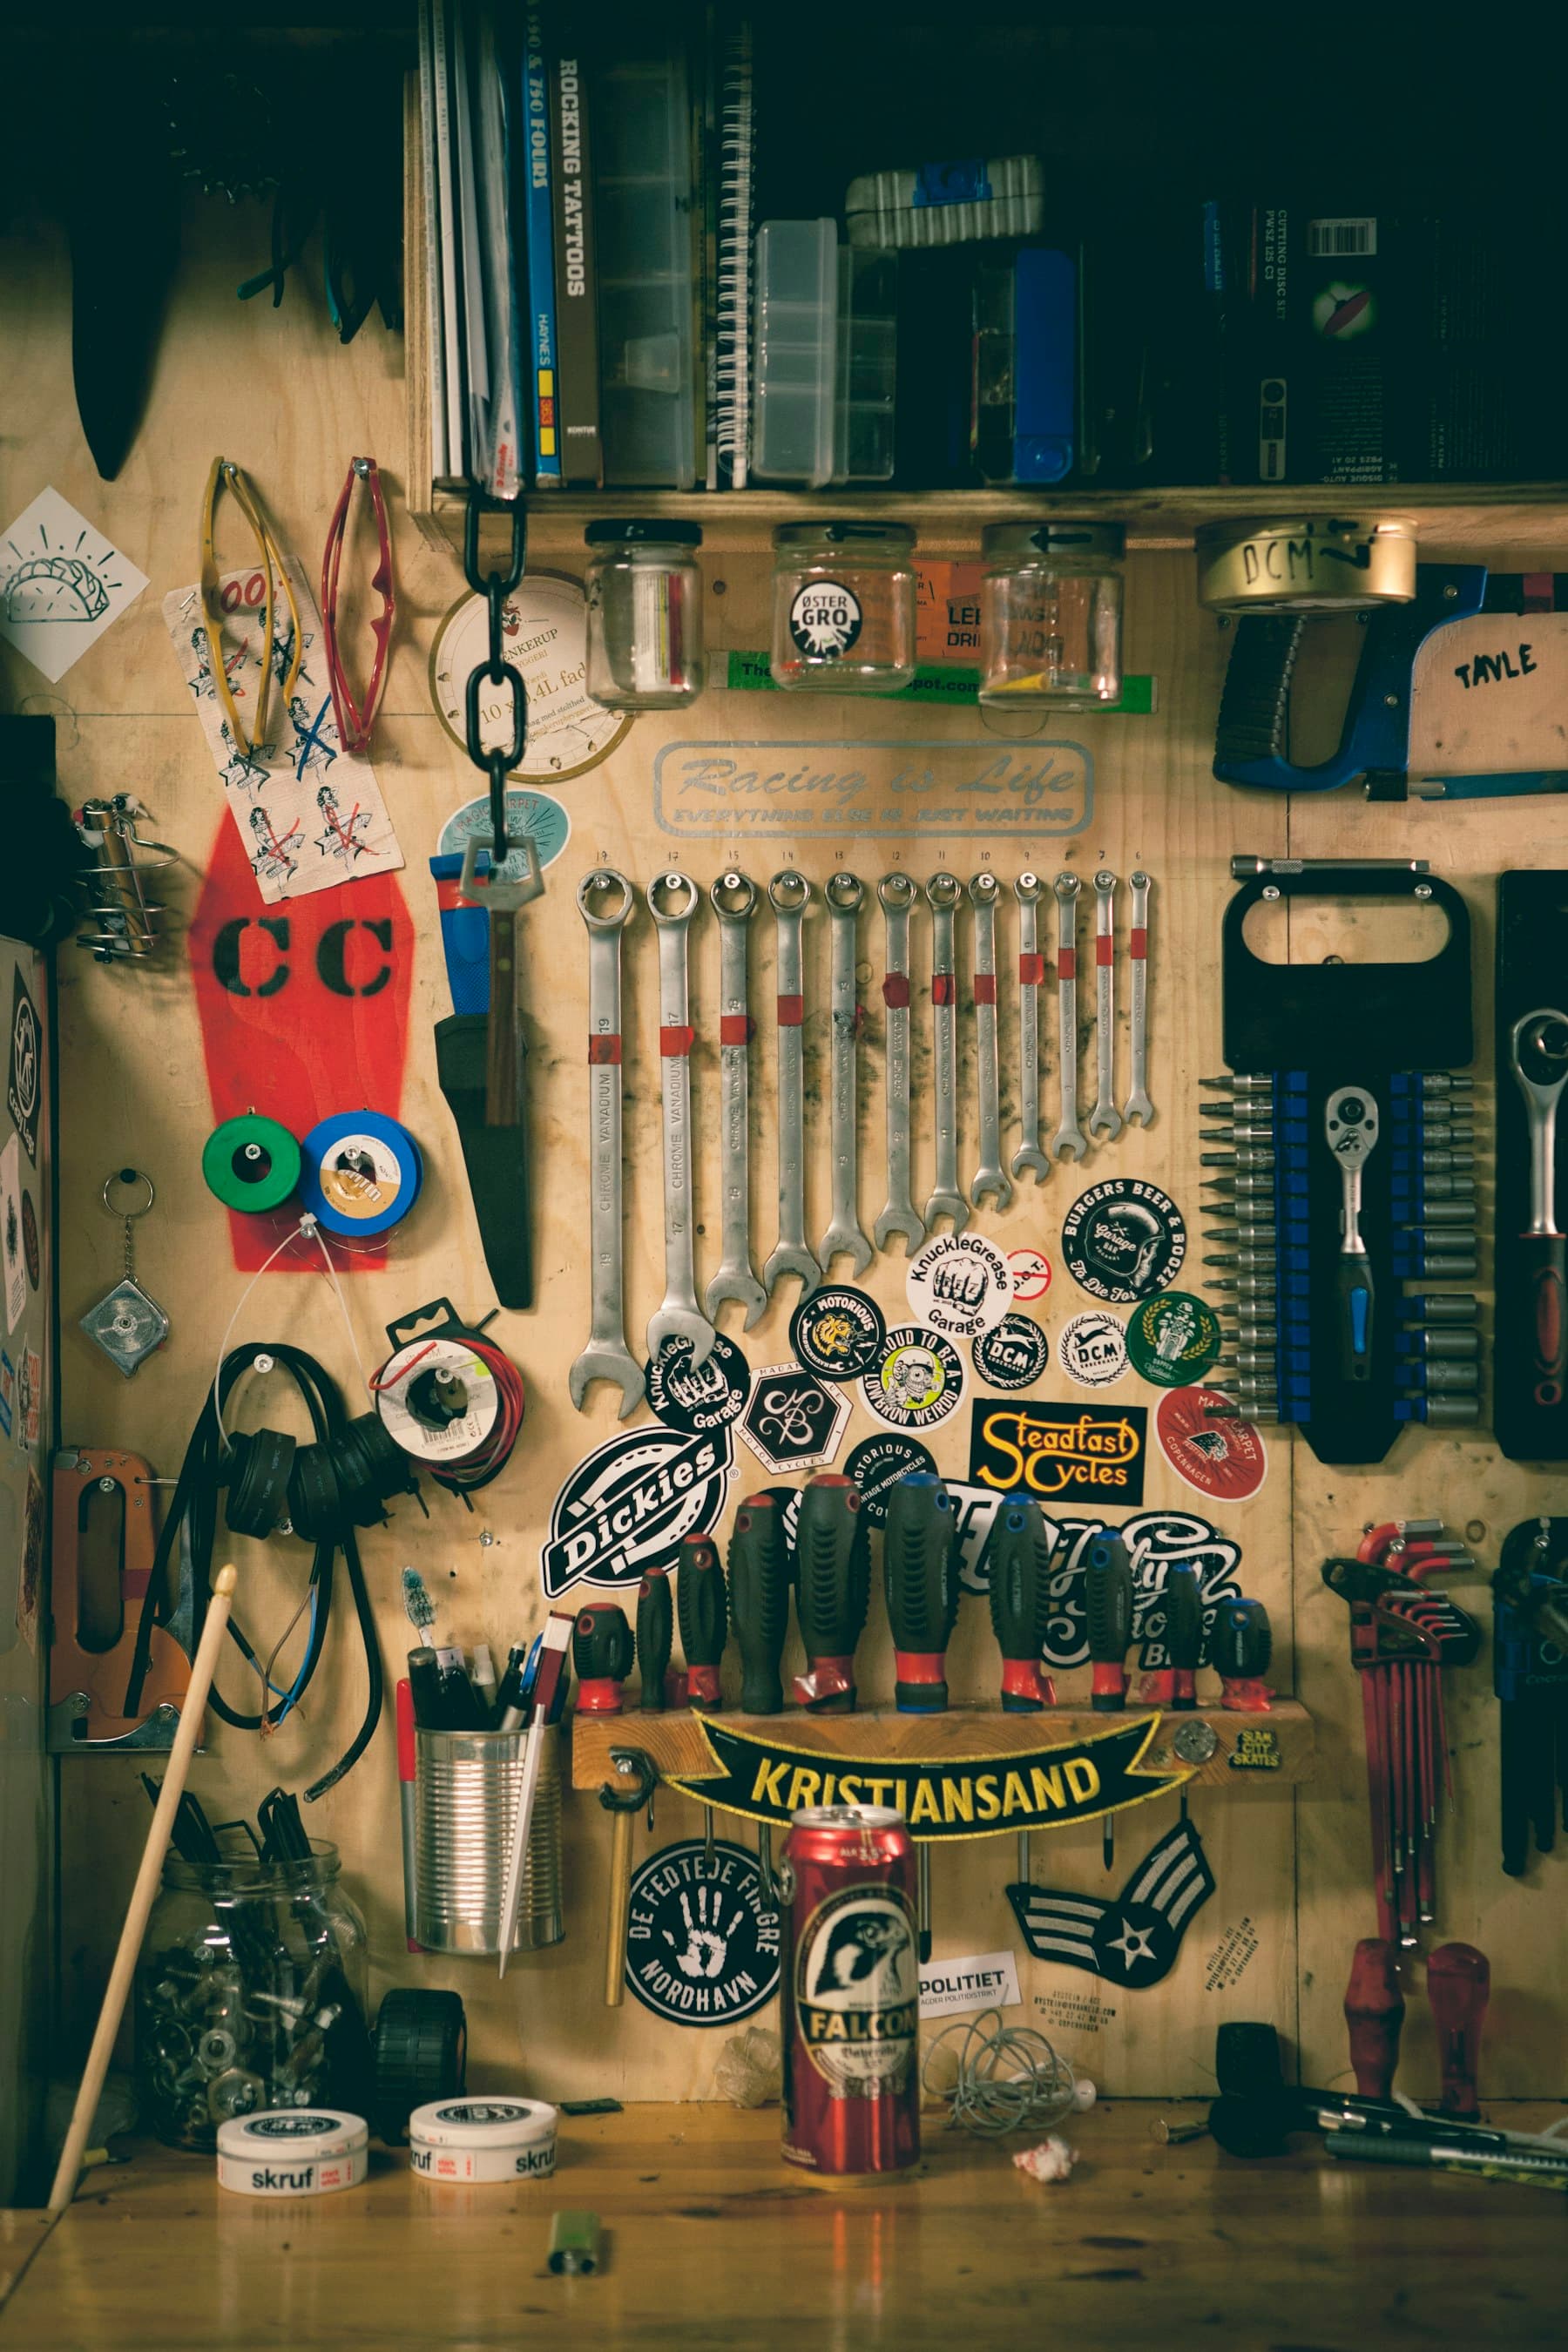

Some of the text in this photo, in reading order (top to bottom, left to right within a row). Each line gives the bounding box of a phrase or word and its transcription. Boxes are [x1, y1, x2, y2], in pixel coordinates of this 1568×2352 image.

[529, 77, 544, 112] 750
[530, 118, 548, 189] FOURS
[559, 58, 585, 297] ROCKING TATTOOS
[1265, 209, 1275, 242] PWSZ
[1264, 246, 1274, 262] 125
[1275, 209, 1288, 321] CUTTING DISC SET
[538, 314, 551, 366] HAYNES
[1243, 539, 1314, 585] DCM
[801, 609, 848, 625] GRO
[802, 595, 848, 609] ØSTER
[1454, 643, 1538, 689] TAVLE
[480, 703, 502, 725] 10
[557, 695, 585, 714] stolthed
[676, 754, 1075, 806] Racing is Life
[672, 807, 1074, 823] EVERYTHING ELSE IS JUST WAITING
[596, 851, 609, 862] 19
[667, 851, 679, 862] 17
[728, 850, 739, 861] 15
[782, 851, 794, 862] 14
[835, 850, 844, 861] 13
[892, 851, 901, 861] 12
[980, 851, 990, 861] 10
[598, 1018, 611, 1034] 19
[669, 1012, 679, 1026] 17
[730, 1047, 740, 1150] CHROME VANADIUM
[599, 1072, 612, 1213] CHROME VANADIUM
[671, 1058, 685, 1190] CHROME VANADIUM
[672, 1221, 684, 1235] 17
[1064, 1181, 1186, 1287] BURGERS BEER & BOOZE
[1094, 1222, 1137, 1252] Garage
[1103, 1241, 1119, 1254] BAR
[910, 1236, 1008, 1290] KnuckleGrease
[1070, 1260, 1138, 1301] To Die For
[817, 1296, 875, 1331] MOTORIOUS
[928, 1308, 986, 1336] Garage
[921, 1330, 962, 1378] TO BE A
[989, 1342, 1029, 1369] DCM
[1078, 1342, 1119, 1363] DCM
[693, 1389, 743, 1429] Garage
[864, 1373, 958, 1425] LOWBROW WEIRDO
[739, 1429, 825, 1471] MOTOR CYCLES
[977, 1411, 1139, 1490] Steadfast
[1231, 1419, 1257, 1461] CARPET
[855, 1443, 913, 1489] MOTORIOUS
[880, 1455, 926, 1490] MOTORCYCLES
[1024, 1448, 1128, 1493] Cycles
[1166, 1436, 1213, 1485] COPENHAGEN
[564, 1443, 716, 1576] Dickies
[750, 1756, 1102, 1825] KRISTIANSAND
[628, 1907, 654, 1939] DE
[1234, 1938, 1259, 1977] COPENHAGEN
[639, 1958, 758, 2012] NORDHAVN
[919, 1970, 1004, 1996] POLITIET
[921, 1988, 997, 2005] AGDER POLITIDISTRIKT
[810, 2010, 916, 2041] FALCON
[1058, 2019, 1098, 2032] COPENHAGEN
[251, 2166, 314, 2190] skruf
